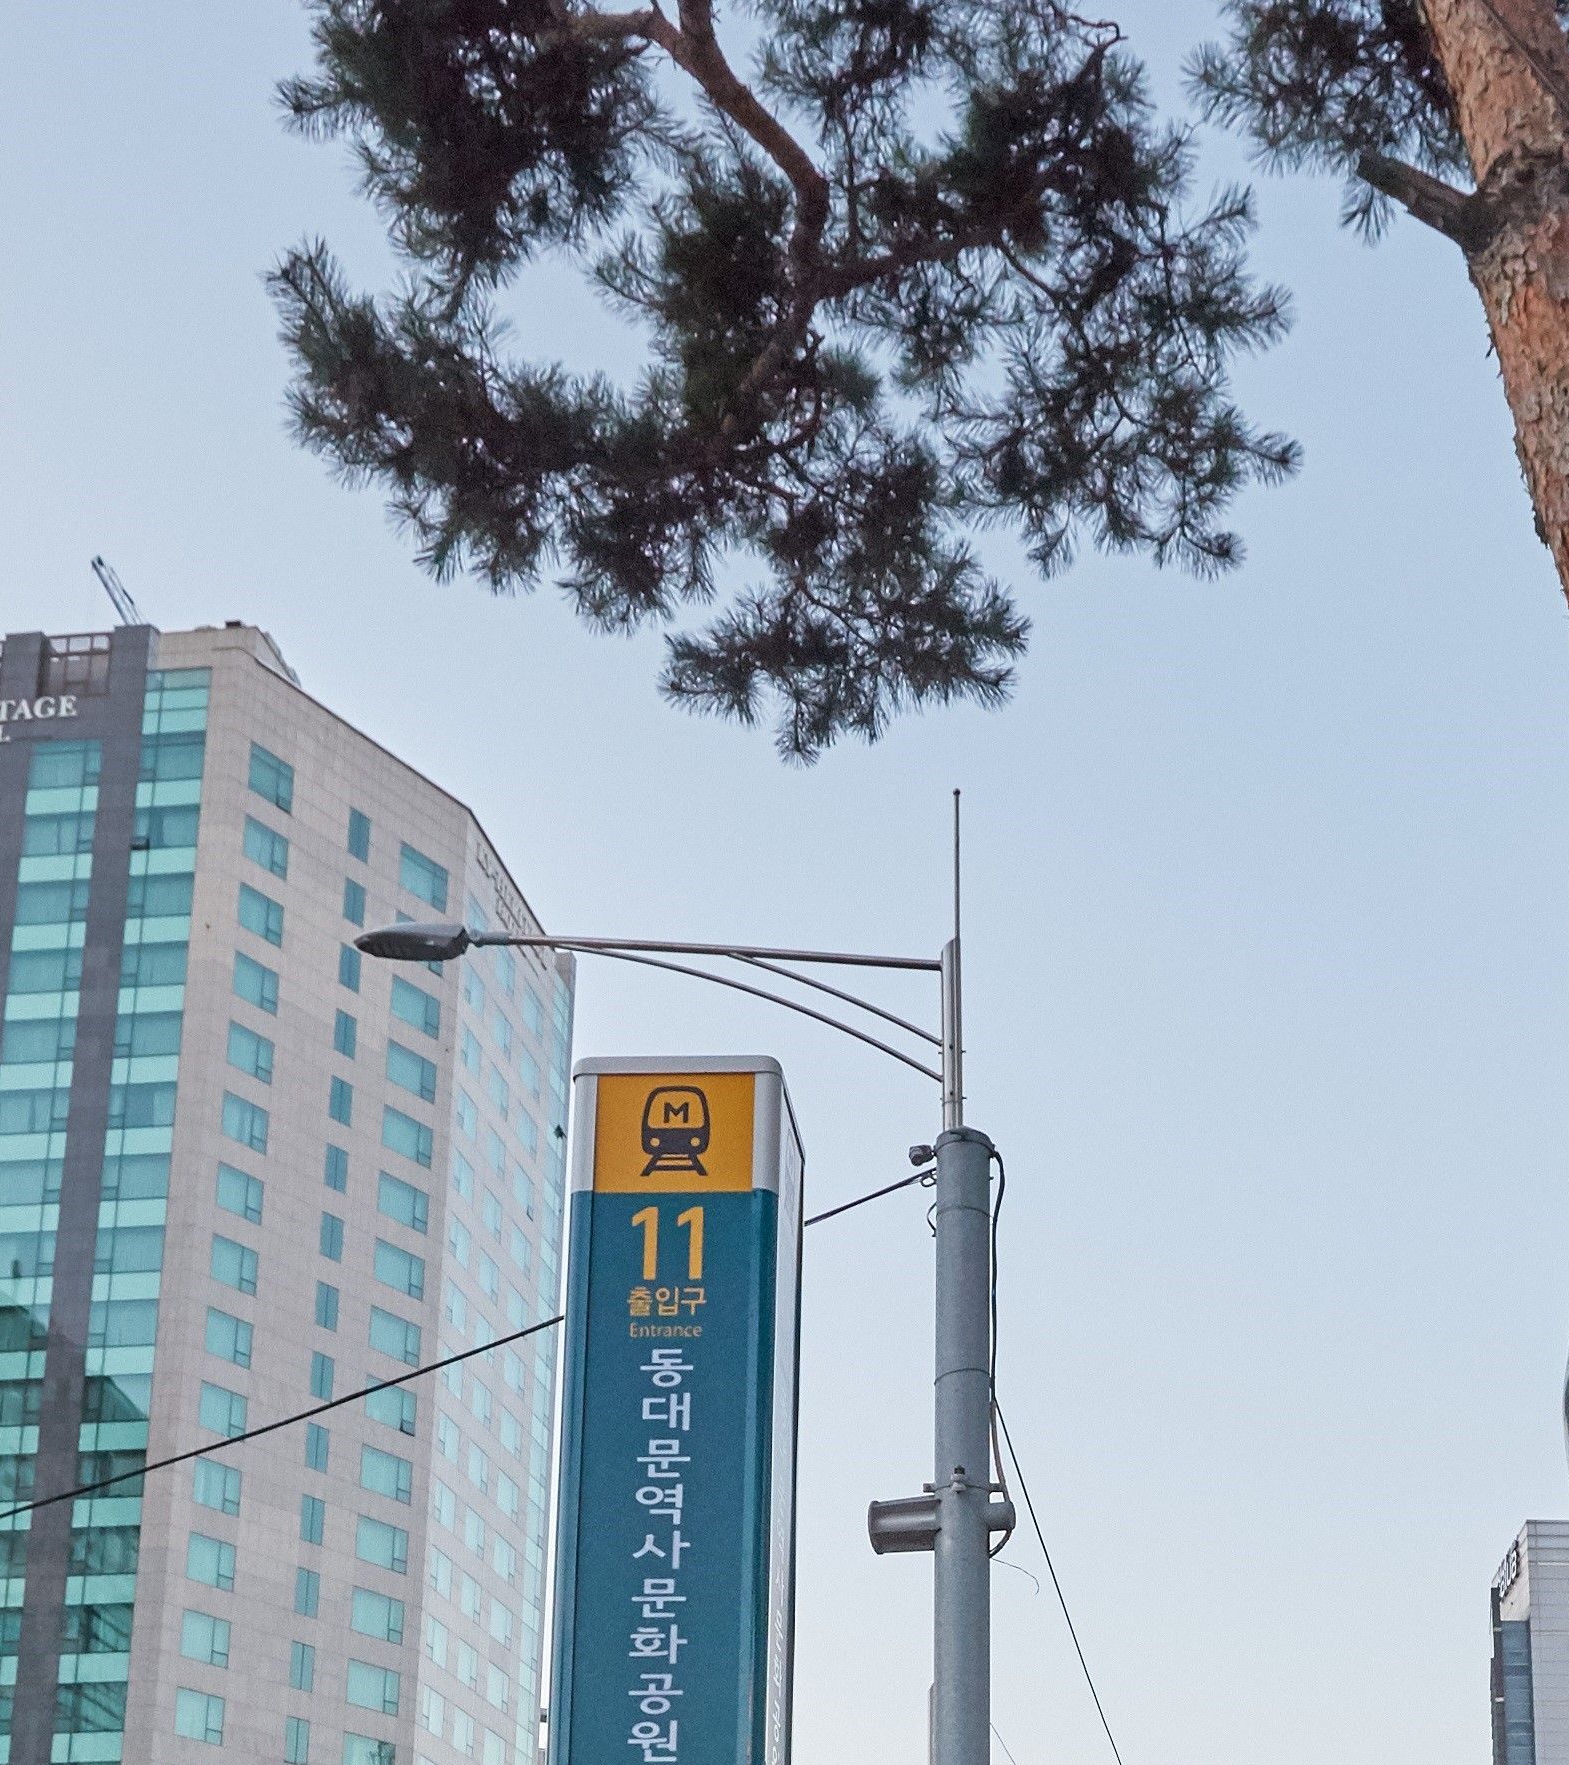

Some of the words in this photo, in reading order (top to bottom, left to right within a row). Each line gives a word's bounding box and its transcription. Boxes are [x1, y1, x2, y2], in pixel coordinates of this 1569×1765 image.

[631, 1206, 704, 1280] 11
[628, 1286, 707, 1317] 출입구
[629, 1323, 703, 1338] Entrance
[627, 1348, 694, 1763] 동대문역사문화공원
